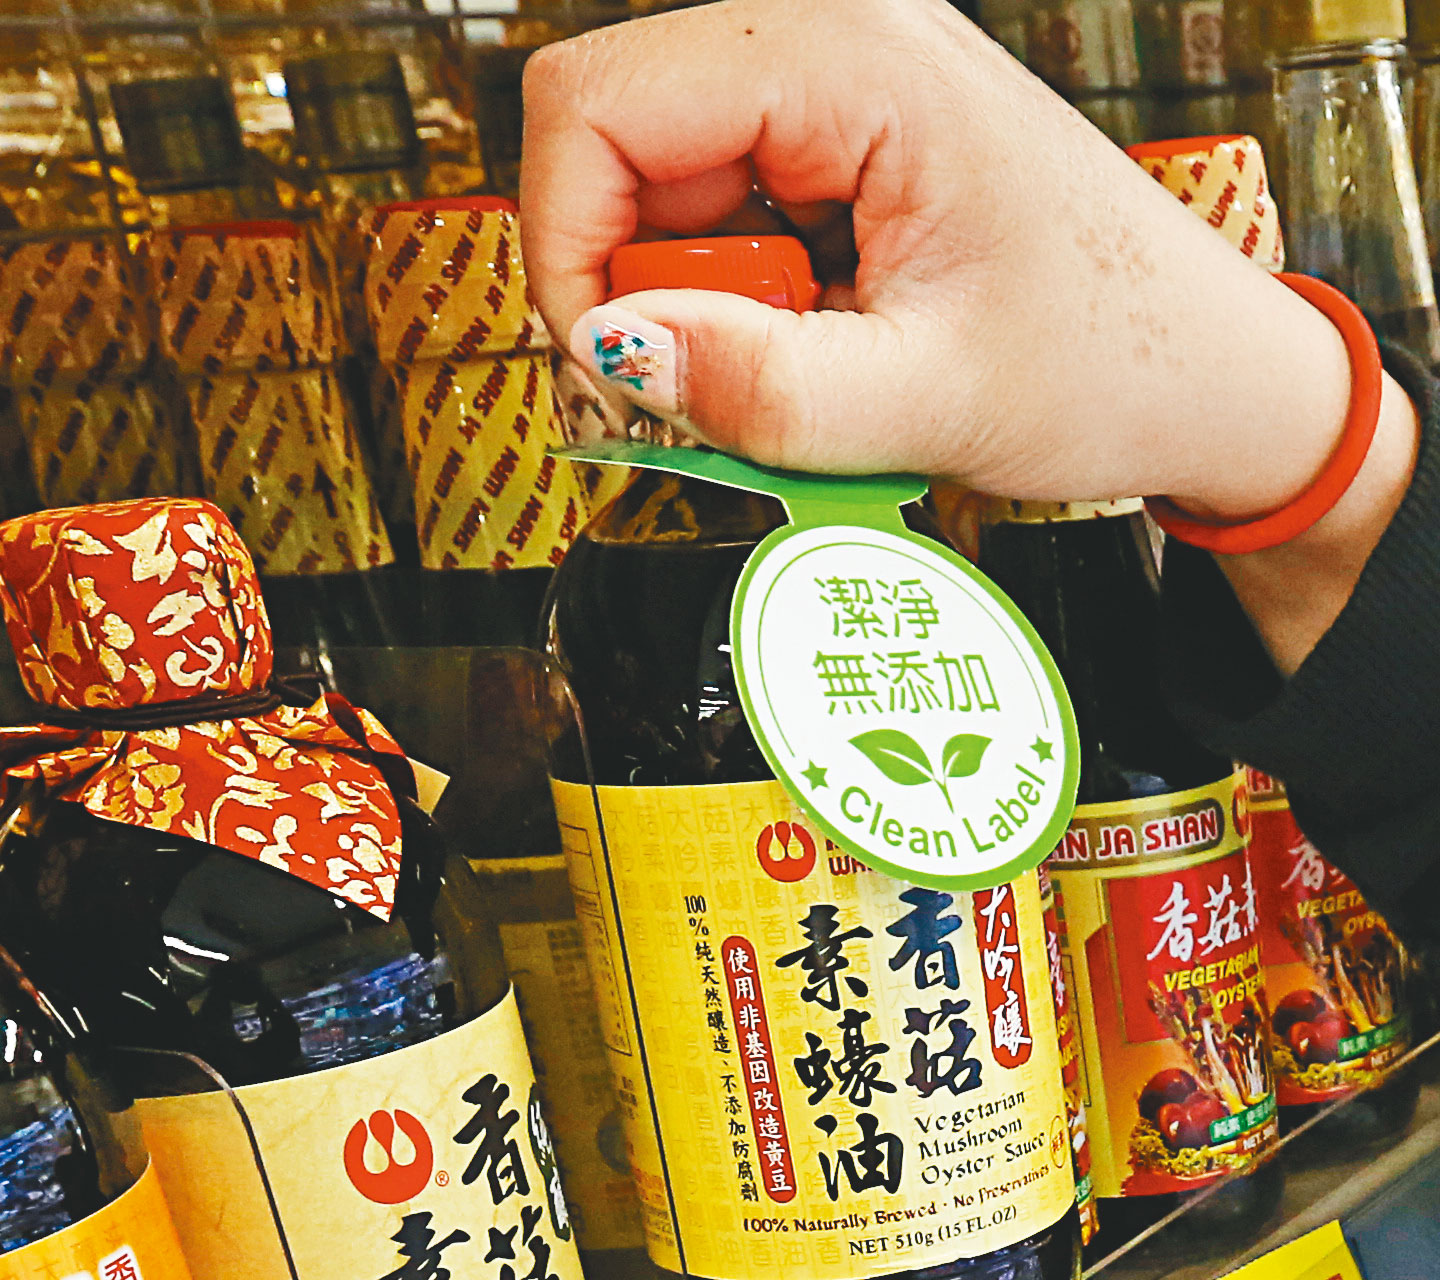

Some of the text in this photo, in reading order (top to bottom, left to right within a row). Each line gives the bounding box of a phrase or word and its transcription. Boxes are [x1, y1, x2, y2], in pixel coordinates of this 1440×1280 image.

[435, 447, 465, 498] WAN
[473, 361, 509, 417] SHAN
[484, 445, 520, 497] WAN
[507, 495, 543, 550] SHAN
[814, 577, 940, 639] 潔淨
[813, 650, 1001, 715] 無添加
[840, 764, 1046, 858] Clean Label
[1099, 830, 1134, 857] JA
[1145, 810, 1217, 850] SHAN
[886, 886, 983, 1099] 香菇
[726, 944, 793, 1193] 使用非基因改造黃豆
[775, 904, 904, 1202] 素蠔油
[914, 1089, 1026, 1136] Vegetarian
[918, 1119, 1023, 1162] Mushroom
[921, 1131, 1047, 1187] Oyster Sauce
[743, 1164, 1049, 1234] 100% Naturally Brewed No Preservatives
[848, 1238, 889, 1257] NET
[895, 1231, 934, 1251] 510g
[937, 1224, 963, 1243] (15
